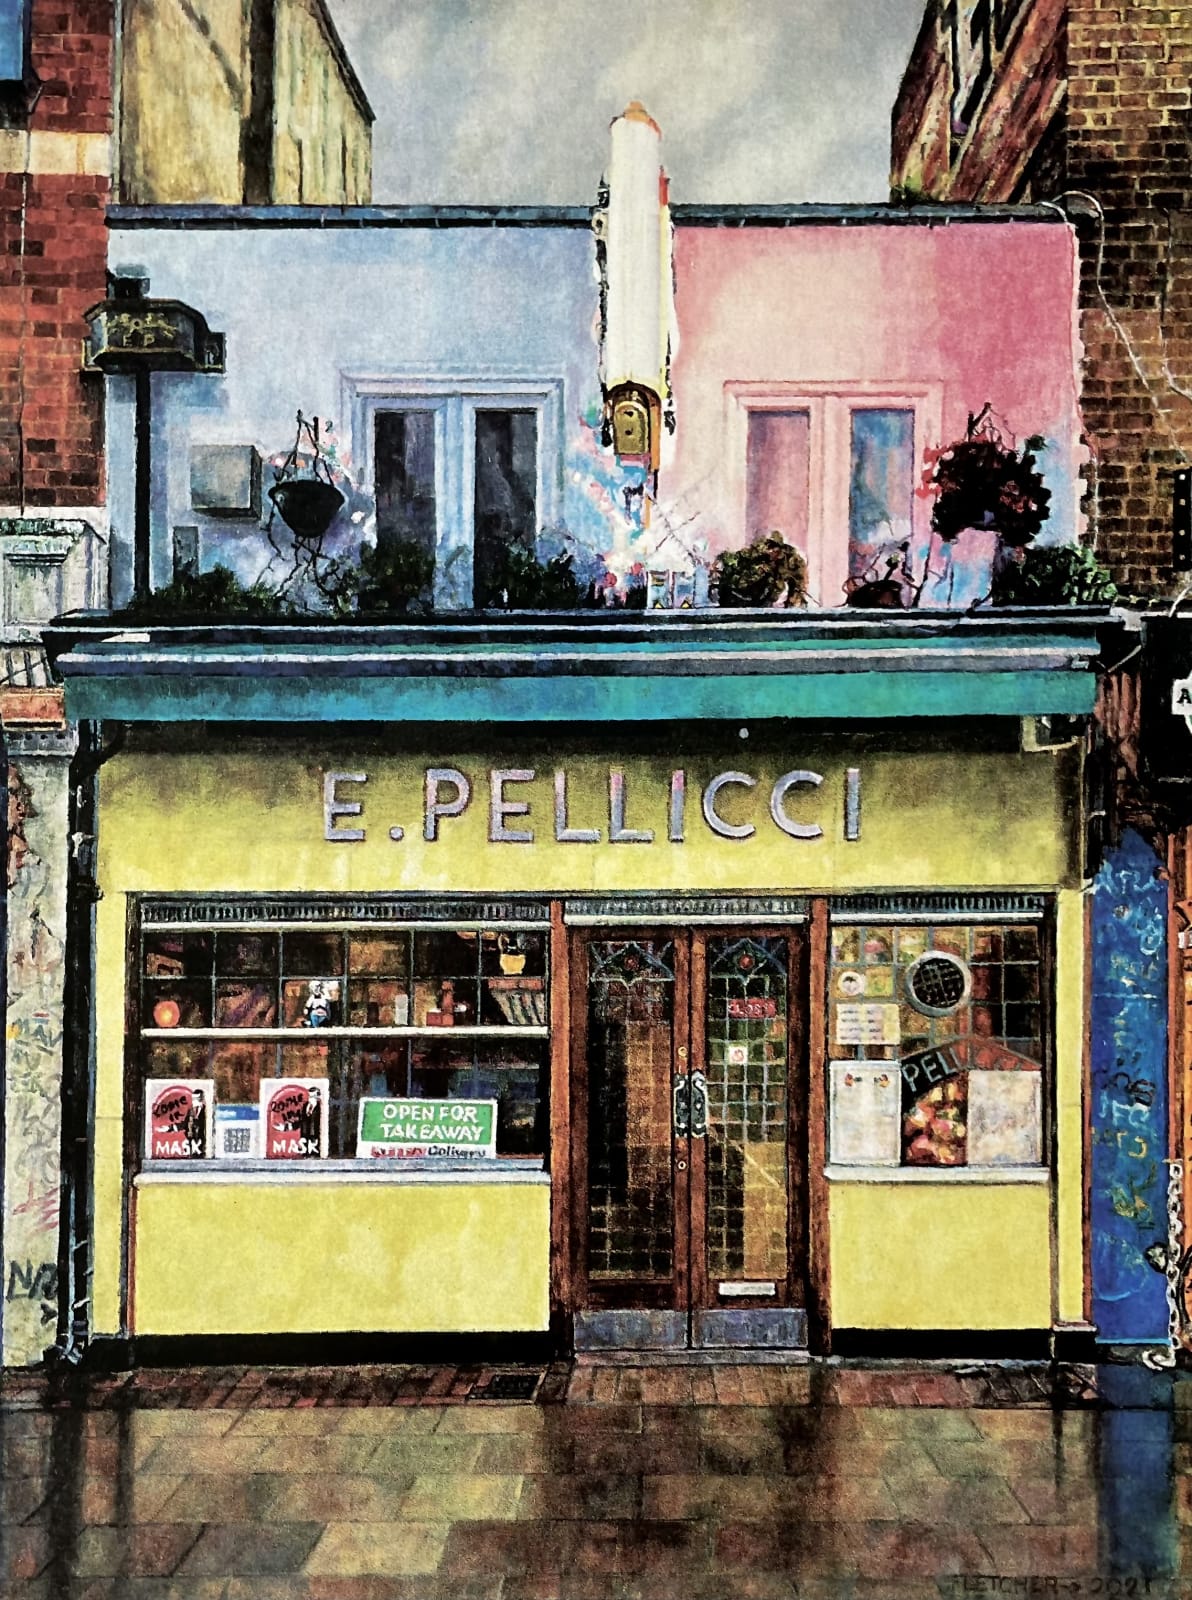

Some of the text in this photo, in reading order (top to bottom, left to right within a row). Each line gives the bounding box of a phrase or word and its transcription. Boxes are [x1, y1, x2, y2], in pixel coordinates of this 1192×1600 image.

[383, 1103, 479, 1123] OPEN FOR
[379, 1123, 485, 1141] TAKEAWAY
[155, 1139, 202, 1155] MASK
[272, 1138, 319, 1154] MASK
